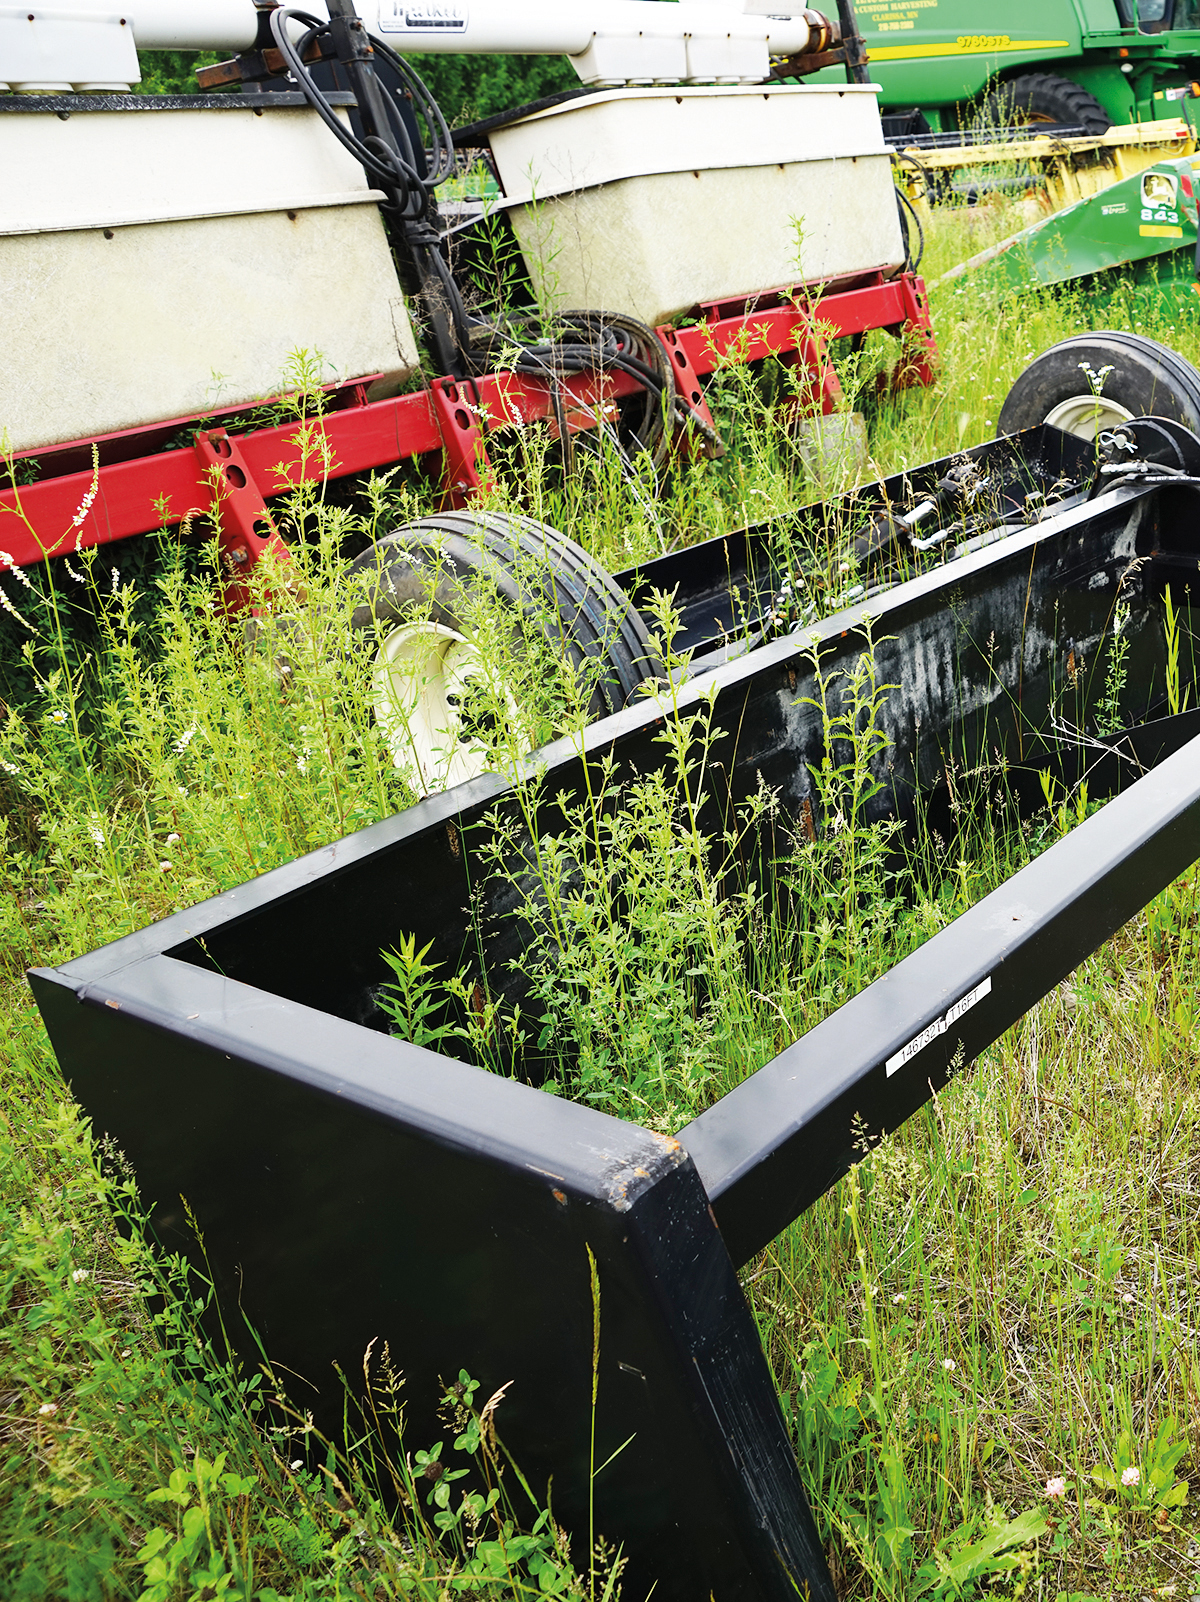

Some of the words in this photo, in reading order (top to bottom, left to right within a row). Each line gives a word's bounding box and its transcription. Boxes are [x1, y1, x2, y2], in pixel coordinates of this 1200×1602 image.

[859, 4, 889, 13] CUSTOM
[891, 0, 938, 10] HARVESTING
[956, 34, 1011, 48] 9760STS
[1141, 209, 1179, 223] 843
